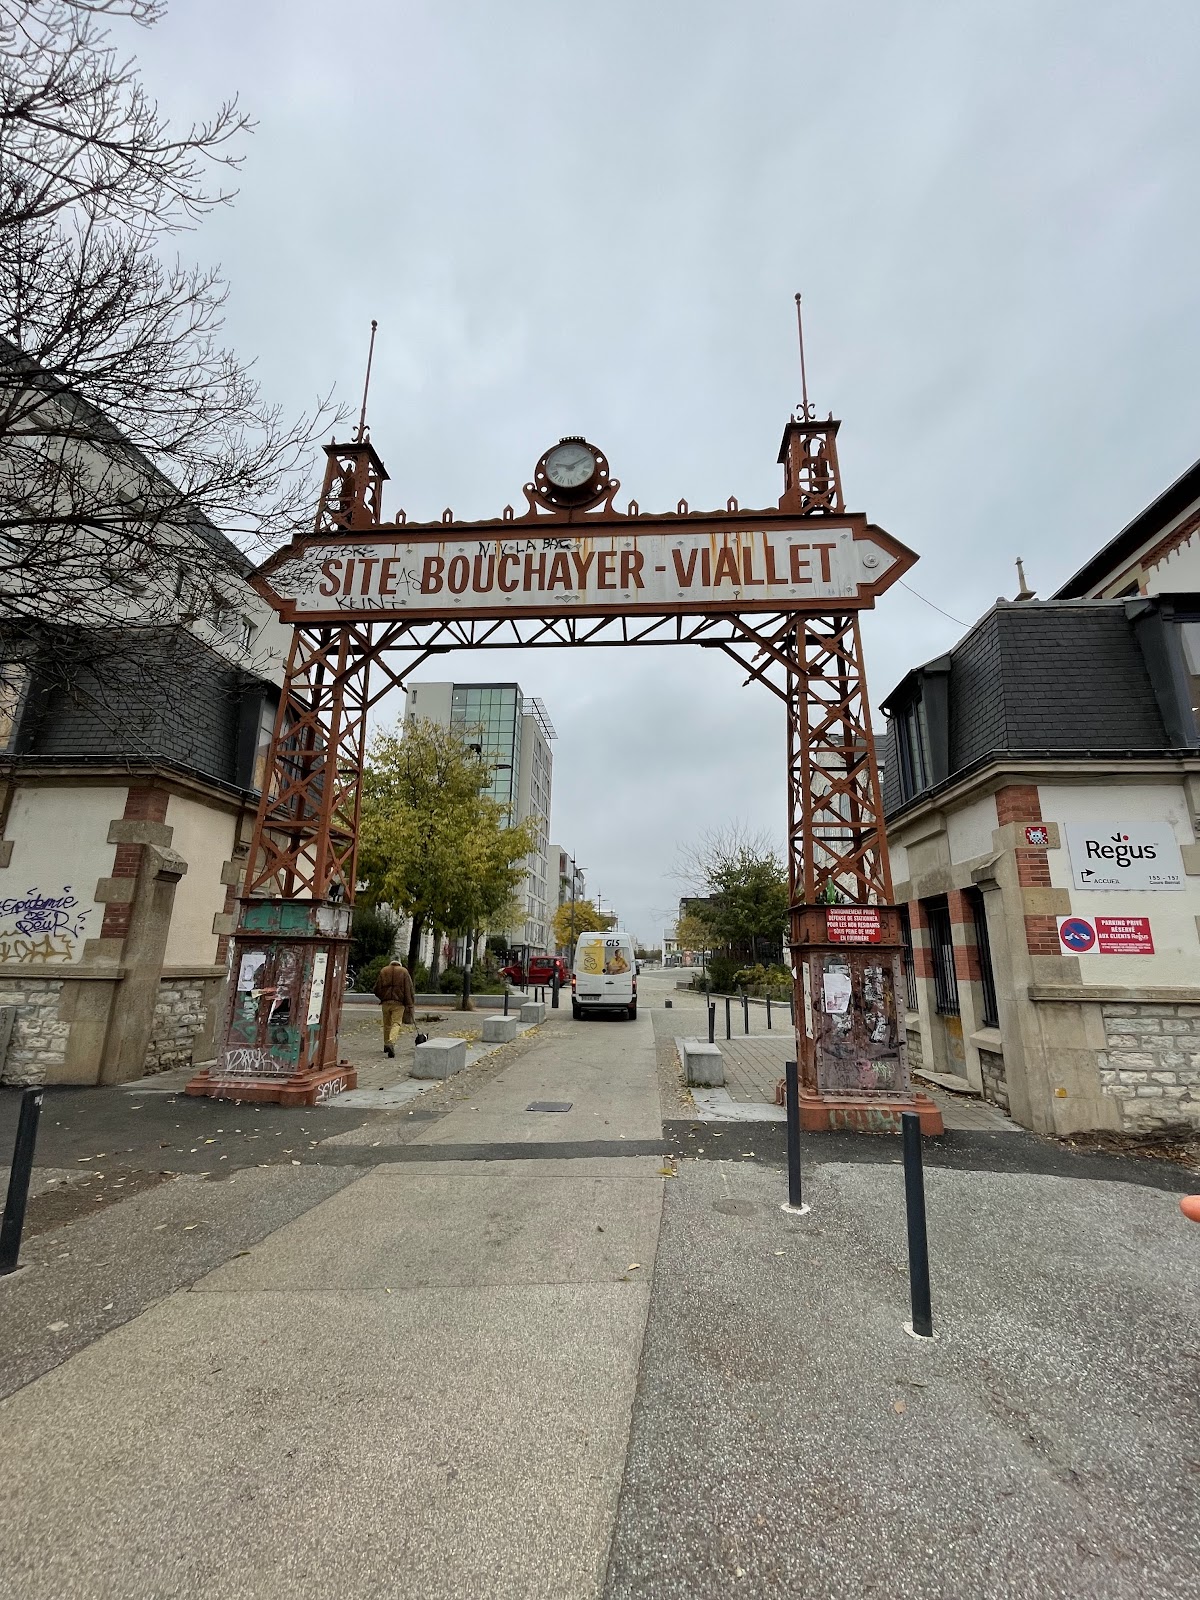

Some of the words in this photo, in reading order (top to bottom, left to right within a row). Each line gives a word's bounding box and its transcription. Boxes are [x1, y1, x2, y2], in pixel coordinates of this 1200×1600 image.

[516, 539, 536, 554] LA
[319, 557, 401, 597] SITE
[1085, 840, 1157, 868] Regus
[605, 939, 620, 947] GLS
[1130, 933, 1149, 941] Regus
